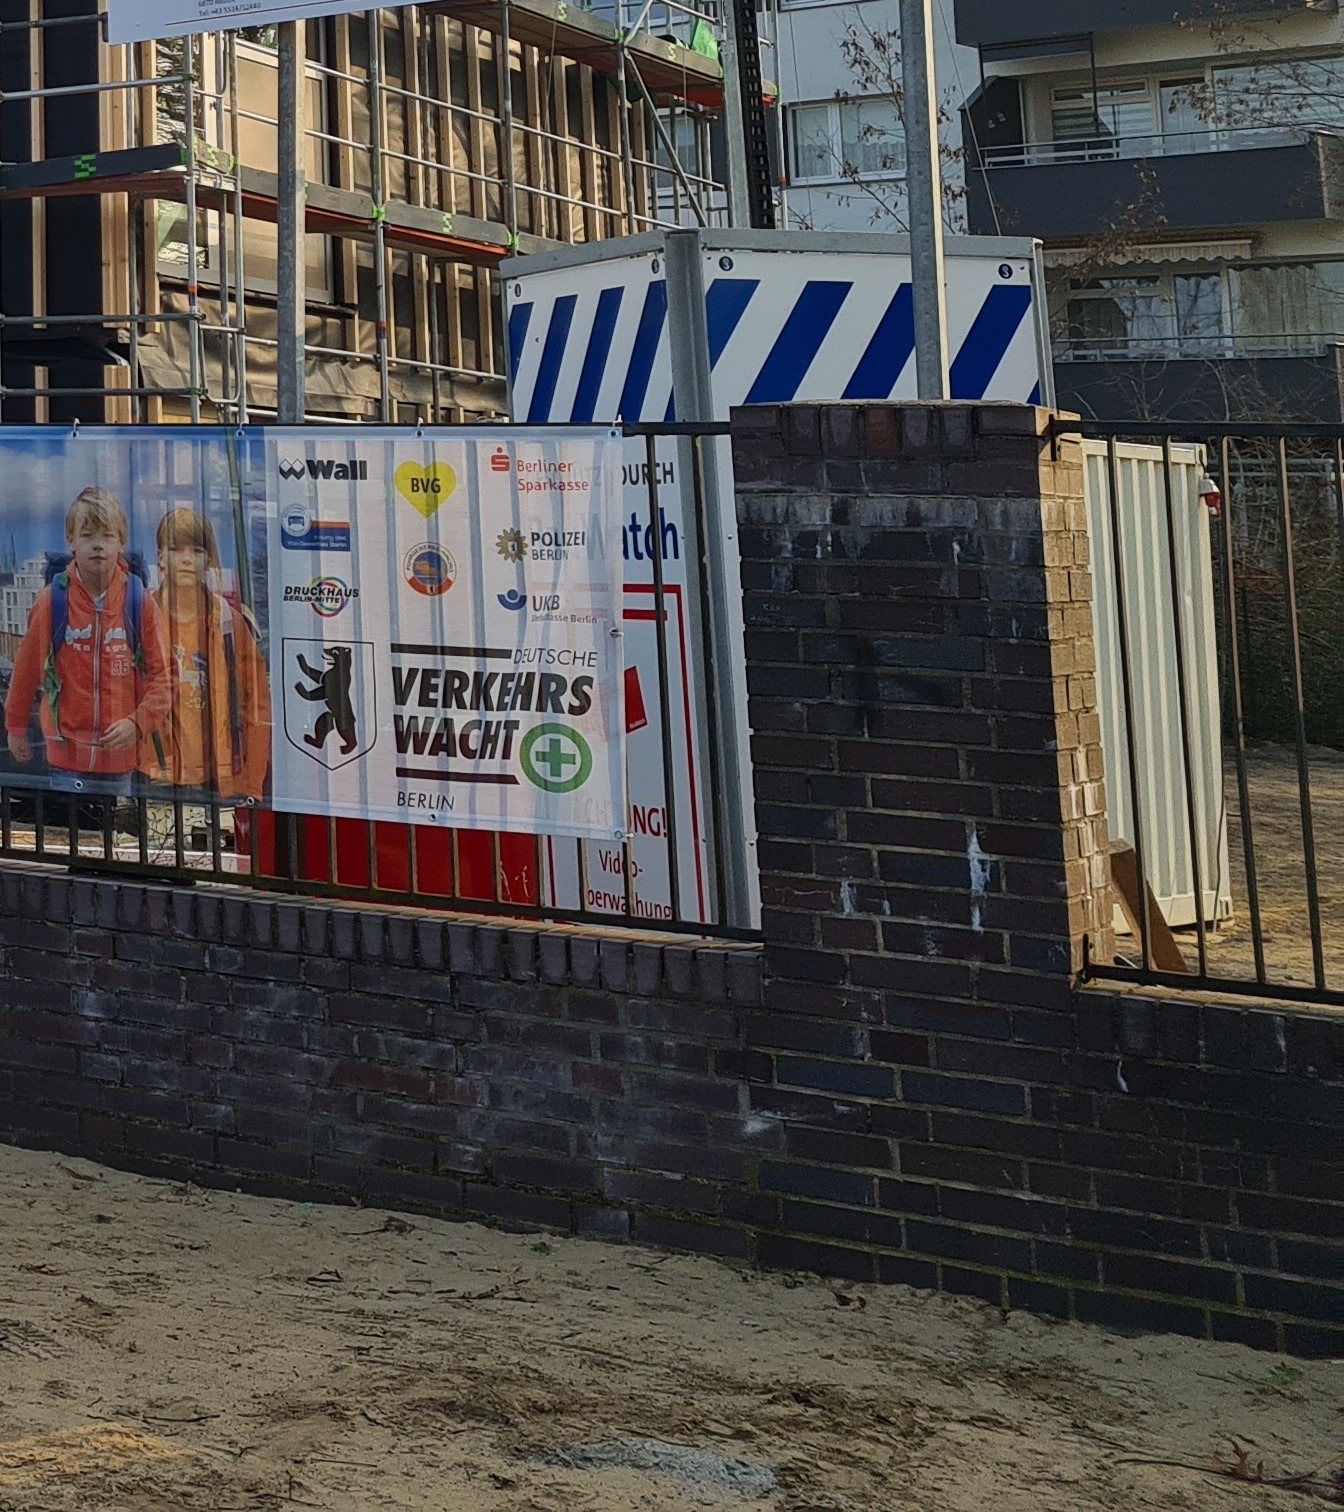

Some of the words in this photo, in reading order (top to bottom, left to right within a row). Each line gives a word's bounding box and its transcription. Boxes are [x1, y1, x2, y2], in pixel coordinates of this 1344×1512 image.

[306, 459, 368, 481] Wall
[516, 459, 574, 473] Berliner
[410, 477, 442, 494] BVG
[517, 478, 589, 494] Sparkasse
[531, 531, 586, 547] POLIZEI
[531, 549, 569, 561] BERLIN
[284, 585, 360, 598] DRUCKHAUS
[532, 594, 560, 612] UKB
[513, 648, 599, 668] DEUTSCHE
[391, 666, 595, 717] VERKEHRS
[393, 714, 521, 761] WACHT
[396, 791, 455, 811] BERLIN
